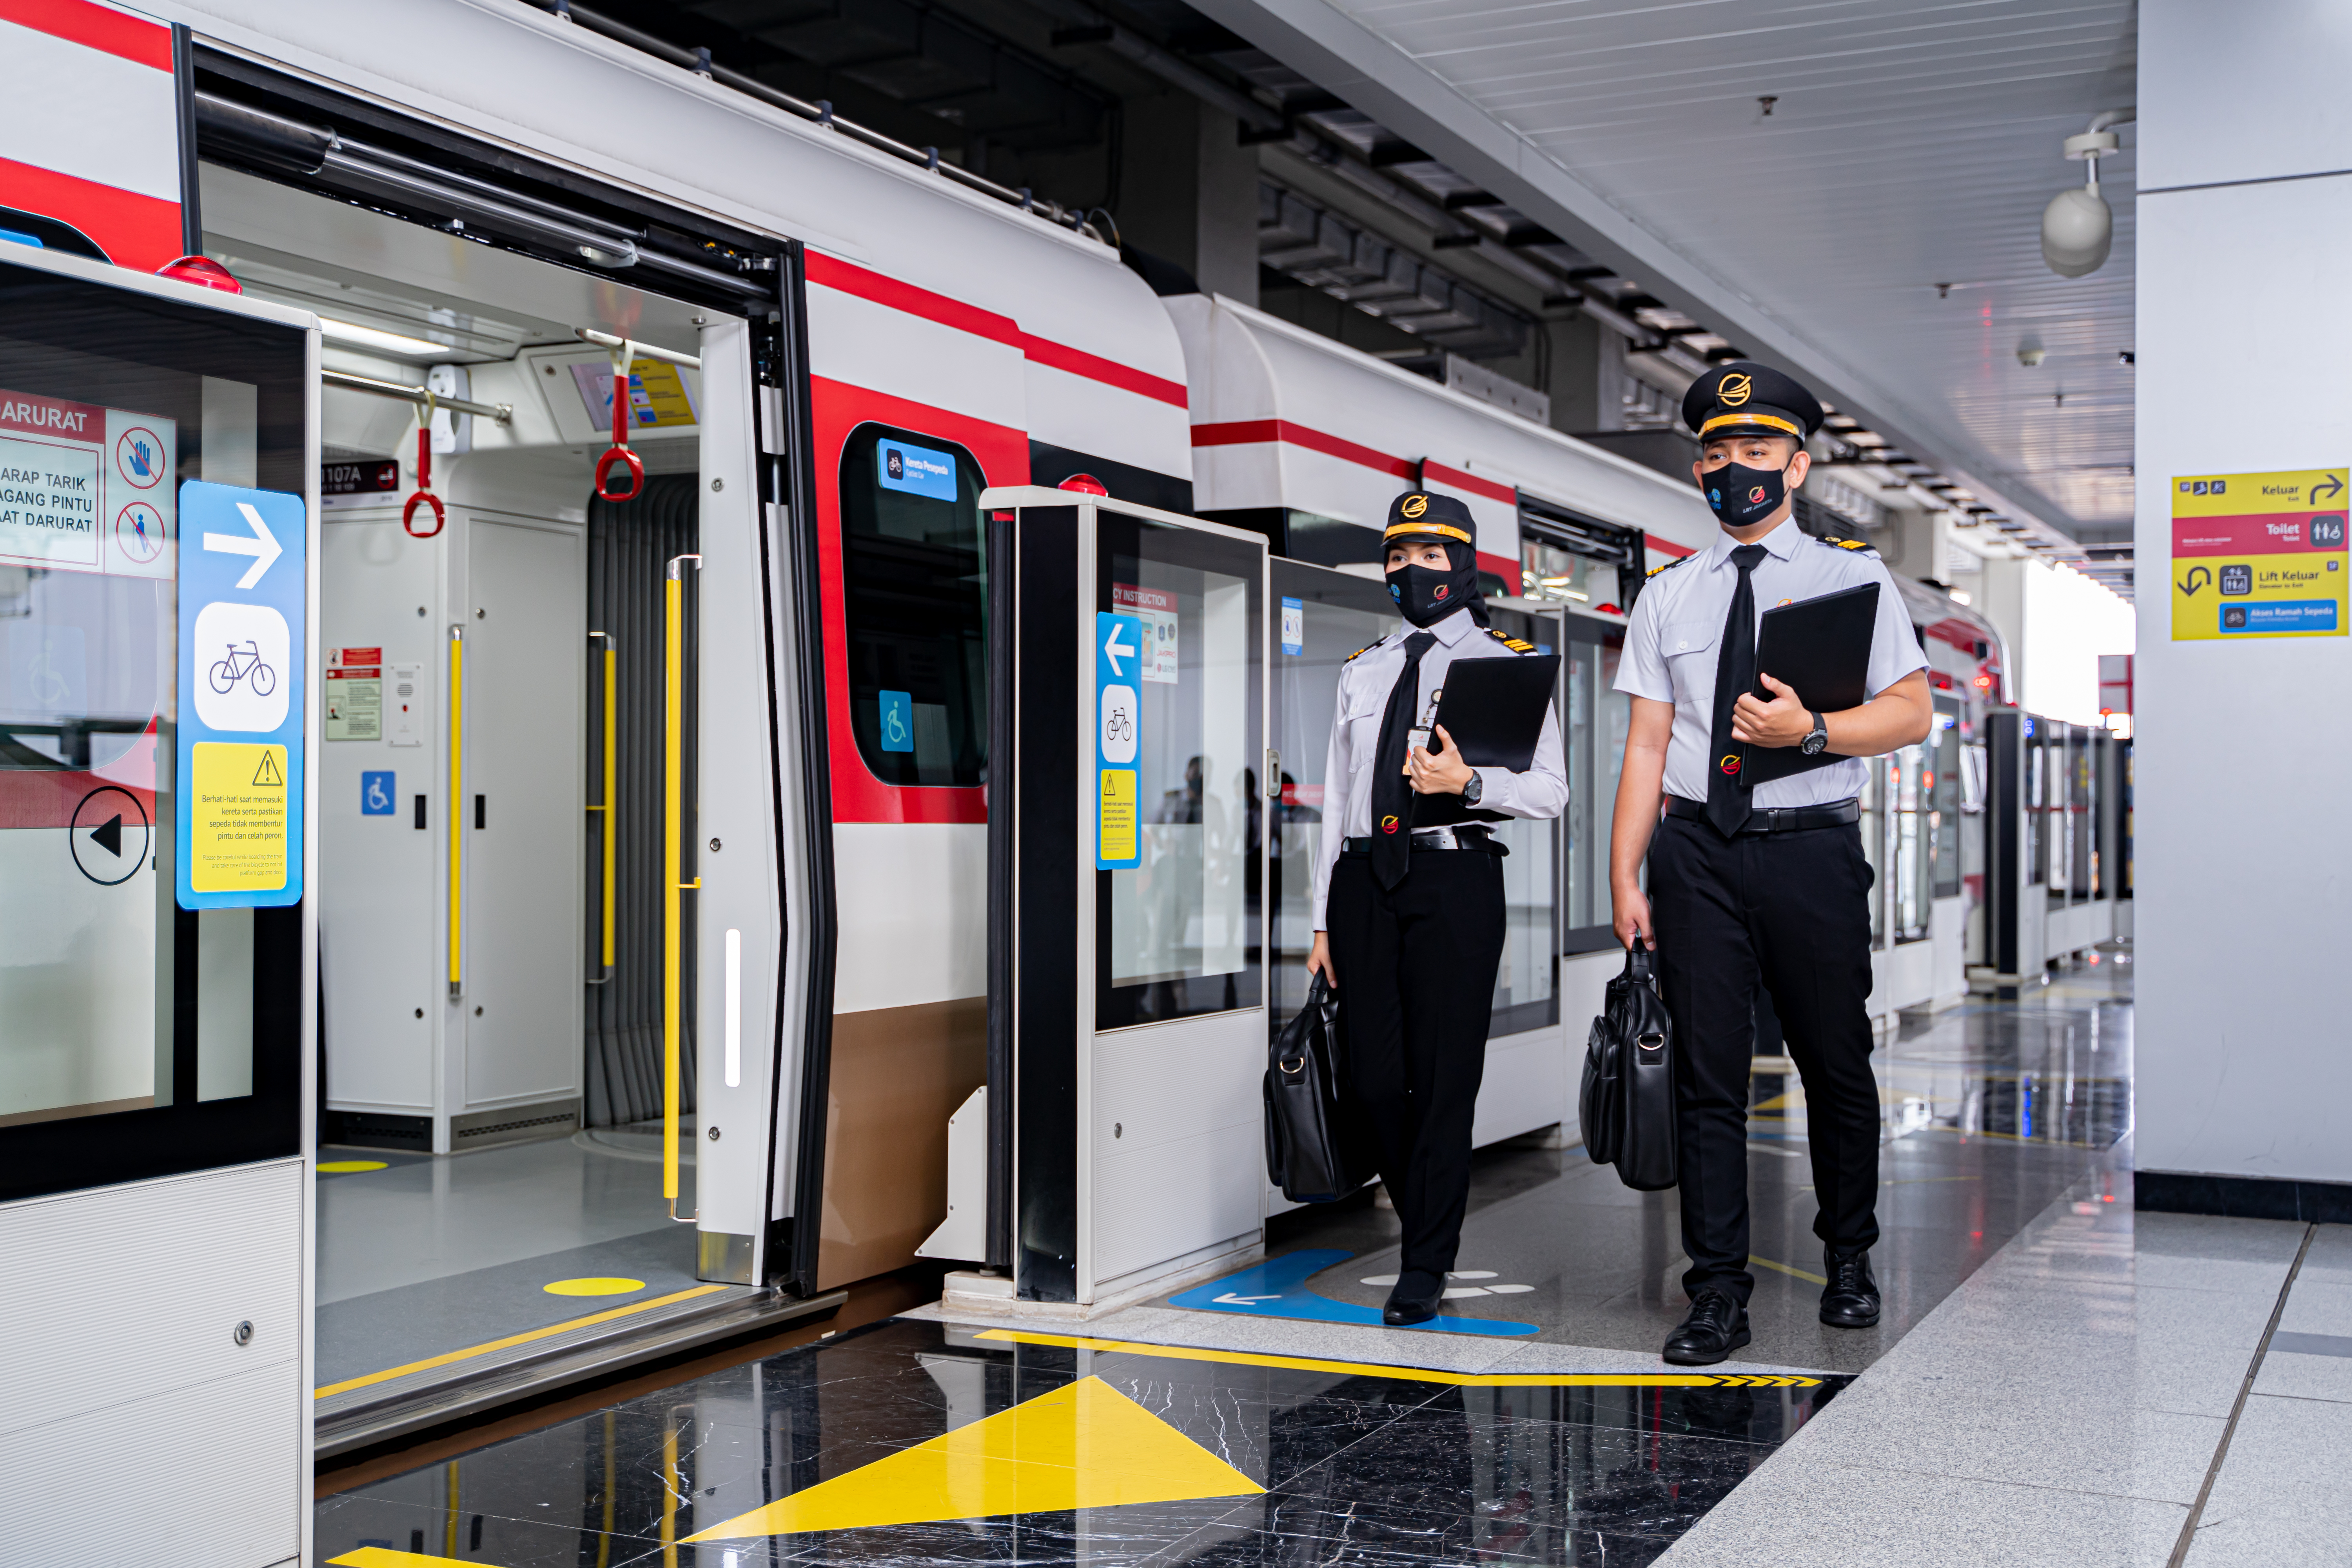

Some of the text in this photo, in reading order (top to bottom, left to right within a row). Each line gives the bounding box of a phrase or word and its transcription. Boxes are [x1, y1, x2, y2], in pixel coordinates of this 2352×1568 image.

[0, 401, 87, 432] ARURAT
[1, 467, 86, 491] ARAP TARIK
[2262, 484, 2299, 495] Keluar
[52, 495, 92, 512] PINTU
[0, 510, 93, 533] AT DARURAT
[2265, 523, 2299, 535] Toilet
[2259, 570, 2319, 581] Lift Keluar
[1123, 589, 1167, 607] INSTRUCTION
[258, 808, 283, 817] pastikan
[209, 820, 231, 829] sepeda
[218, 832, 233, 841] pintu
